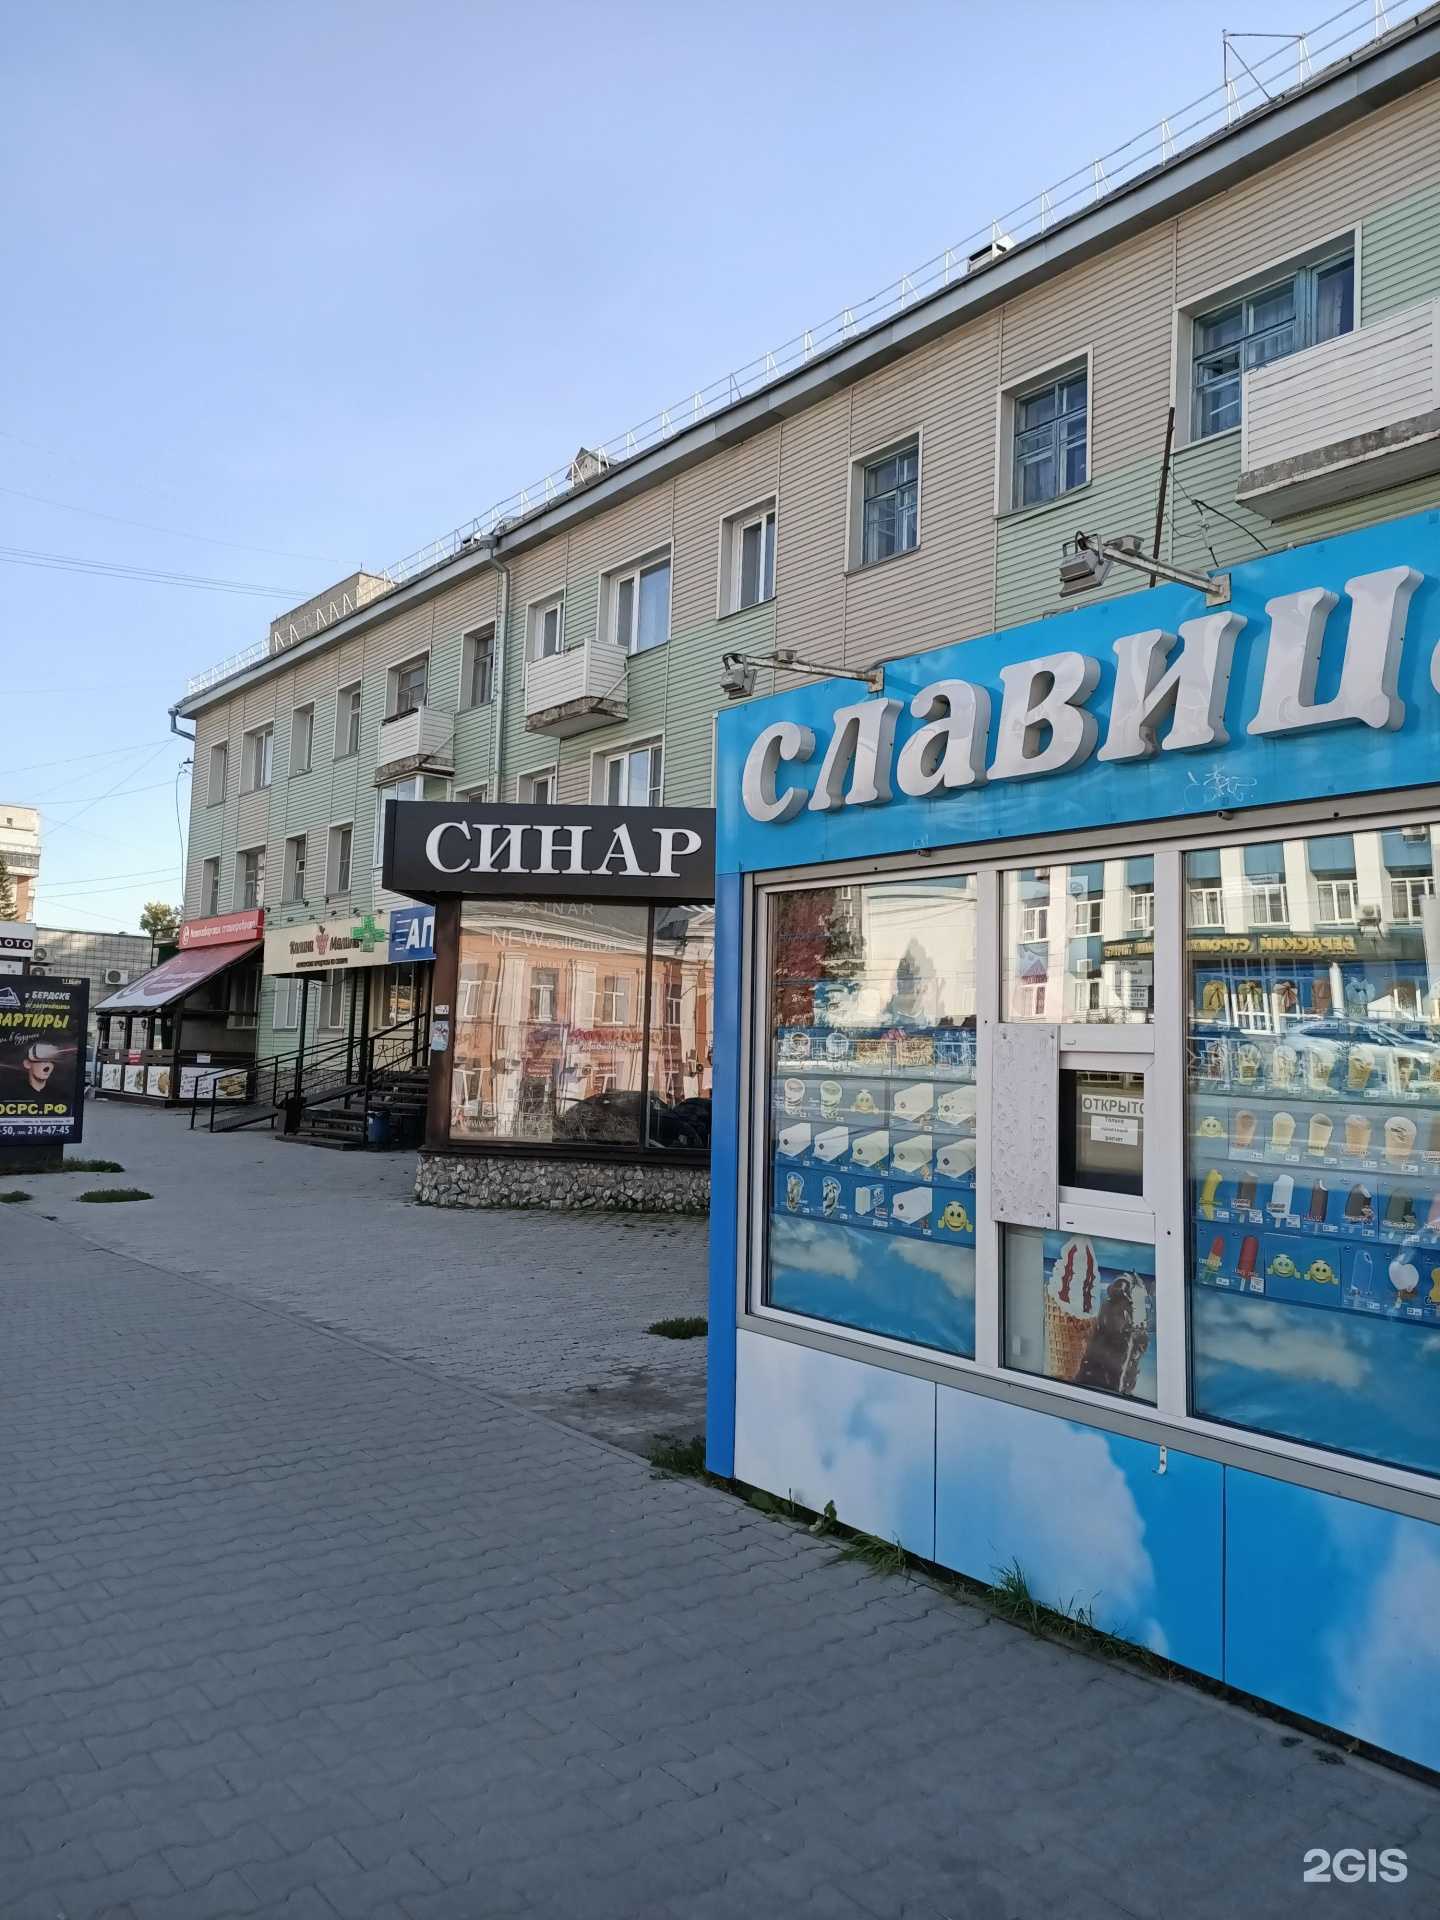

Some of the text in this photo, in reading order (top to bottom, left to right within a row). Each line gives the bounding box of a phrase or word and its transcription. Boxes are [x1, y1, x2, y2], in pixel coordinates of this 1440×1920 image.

[742, 566, 1440, 822] славиц
[425, 820, 702, 877] СИНАР
[0, 938, 32, 949] ОТО
